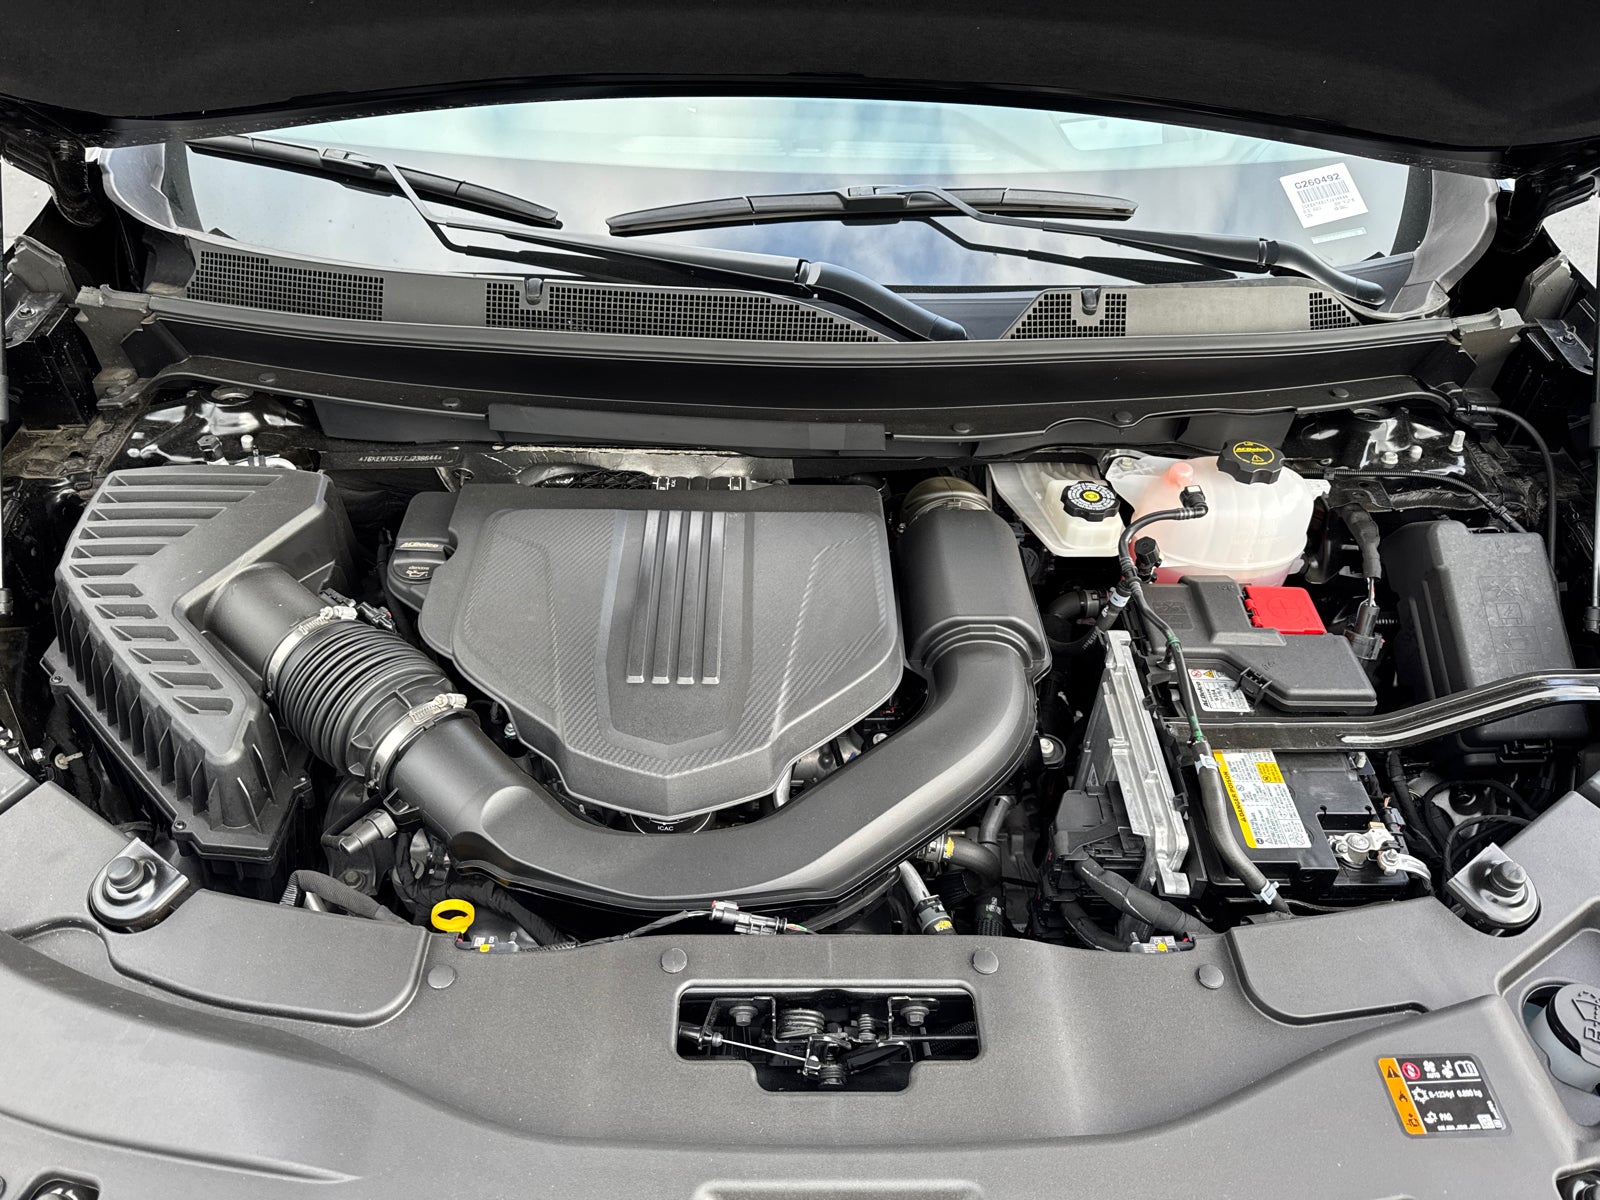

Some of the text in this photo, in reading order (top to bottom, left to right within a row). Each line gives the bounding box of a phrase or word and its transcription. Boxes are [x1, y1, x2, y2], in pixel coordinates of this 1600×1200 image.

[1294, 173, 1340, 190] C260492
[1223, 771, 1245, 817] DANGER POISON
